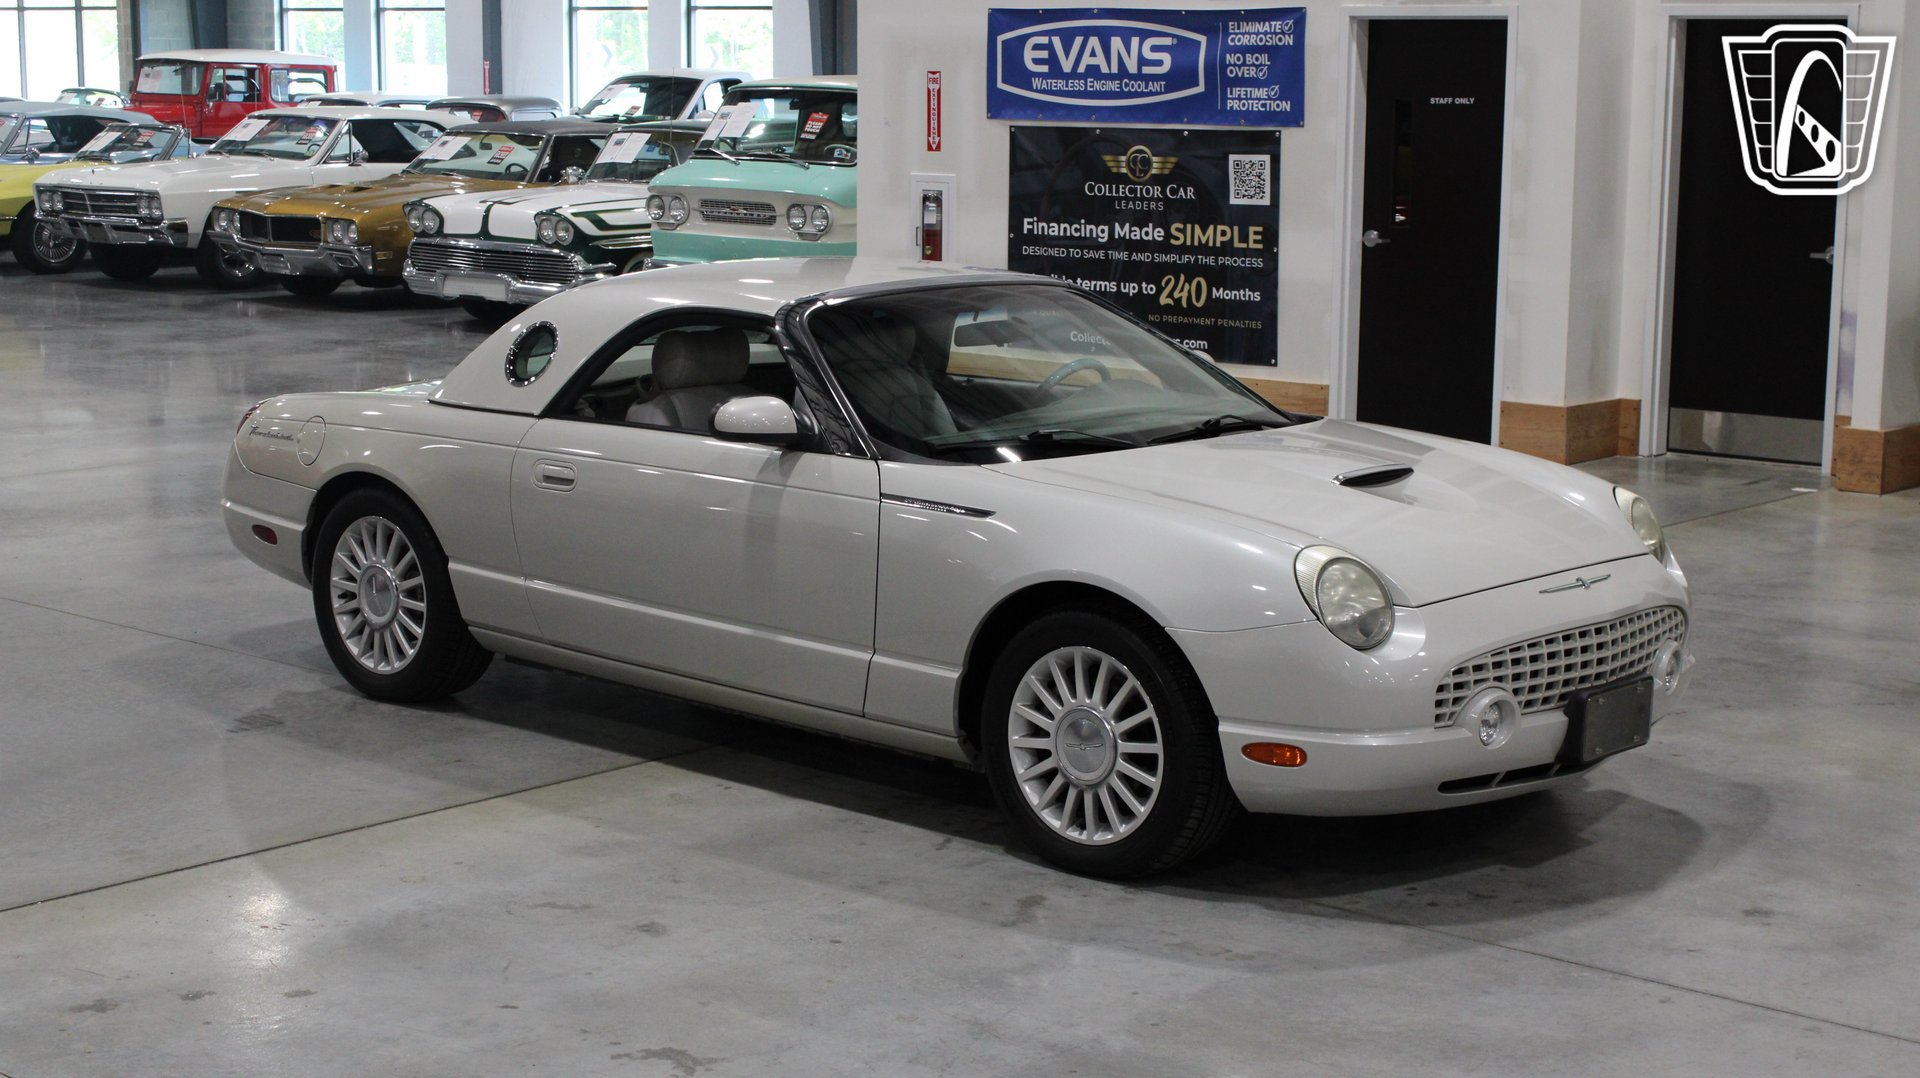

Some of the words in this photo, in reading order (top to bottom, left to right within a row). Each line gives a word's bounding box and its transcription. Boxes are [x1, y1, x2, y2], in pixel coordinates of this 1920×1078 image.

[1228, 21, 1282, 33] ELIMINATE
[1228, 34, 1294, 46] CORROSION
[1023, 35, 1173, 75] EVANS
[1226, 53, 1243, 65] NO
[1245, 53, 1271, 65] BOIL
[1227, 66, 1257, 78] OVER
[928, 77, 940, 85] FIRE
[1032, 77, 1085, 91] WATERLESS
[1087, 78, 1120, 91] ENGINE
[1122, 78, 1166, 92] COOLANT
[1227, 87, 1269, 99] LIFETIME
[1227, 99, 1291, 112] PROTECTION
[1115, 200, 1164, 211] LEADERS
[1023, 216, 1109, 242] Financing
[1114, 222, 1165, 241] Made
[1170, 222, 1264, 249] SIMPLE
[1022, 245, 1067, 257] DESIGNED
[1069, 248, 1081, 258] TO
[1083, 249, 1106, 260] SAVE
[1107, 250, 1129, 261] TIME
[1131, 252, 1152, 262] AND
[1153, 253, 1196, 265] SIMPLIFY
[1197, 255, 1216, 266] THE
[1218, 256, 1264, 268] PROCESS
[1077, 278, 1117, 292] terms
[1120, 281, 1139, 296] up
[1142, 282, 1156, 295] to
[1159, 273, 1208, 308] 240
[1212, 287, 1261, 302] Months
[1148, 314, 1160, 322] NO
[1162, 315, 1215, 326] PREPAYMENT
[1217, 319, 1262, 329] PENALTIES
